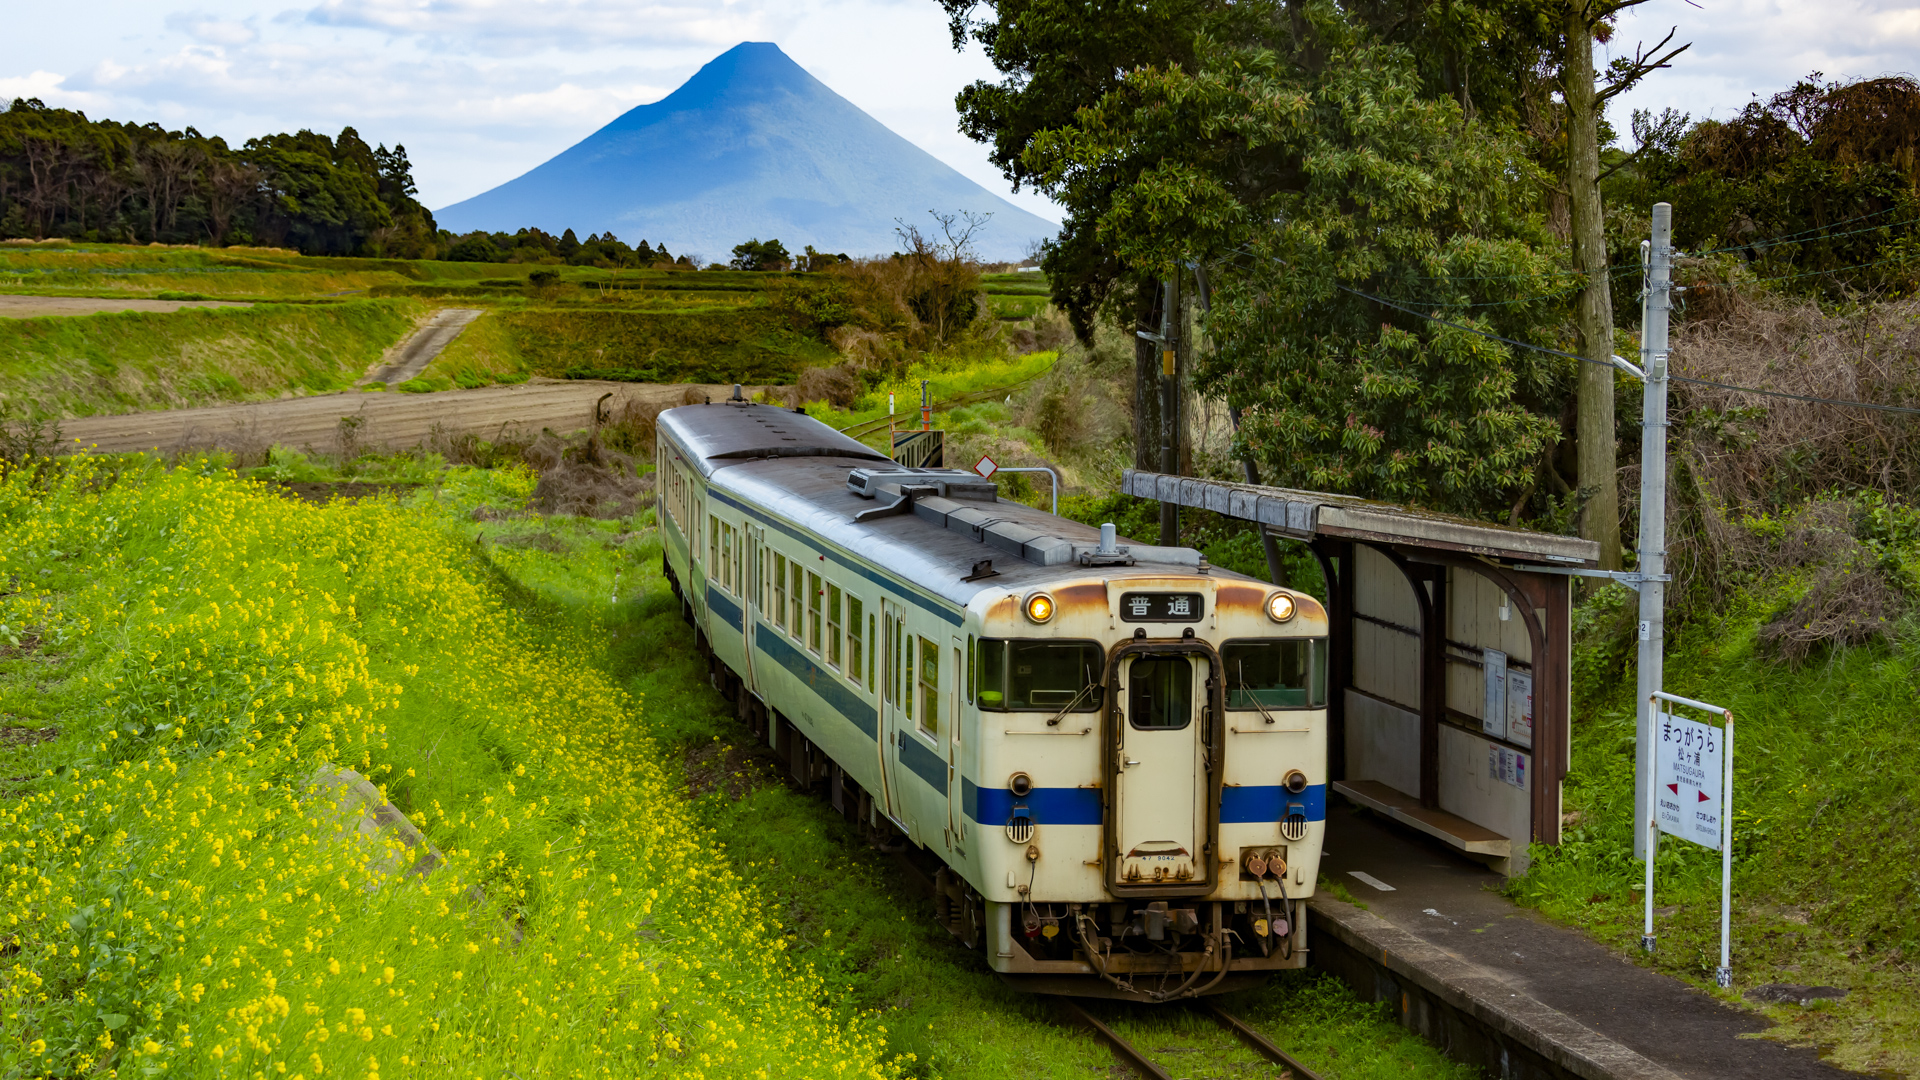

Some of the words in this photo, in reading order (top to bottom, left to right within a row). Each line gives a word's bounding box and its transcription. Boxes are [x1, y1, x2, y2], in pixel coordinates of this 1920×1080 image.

[1128, 596, 1190, 616] 普通
[1663, 721, 1714, 752] まつがうら
[1673, 762, 1705, 779] MATSUGAURA
